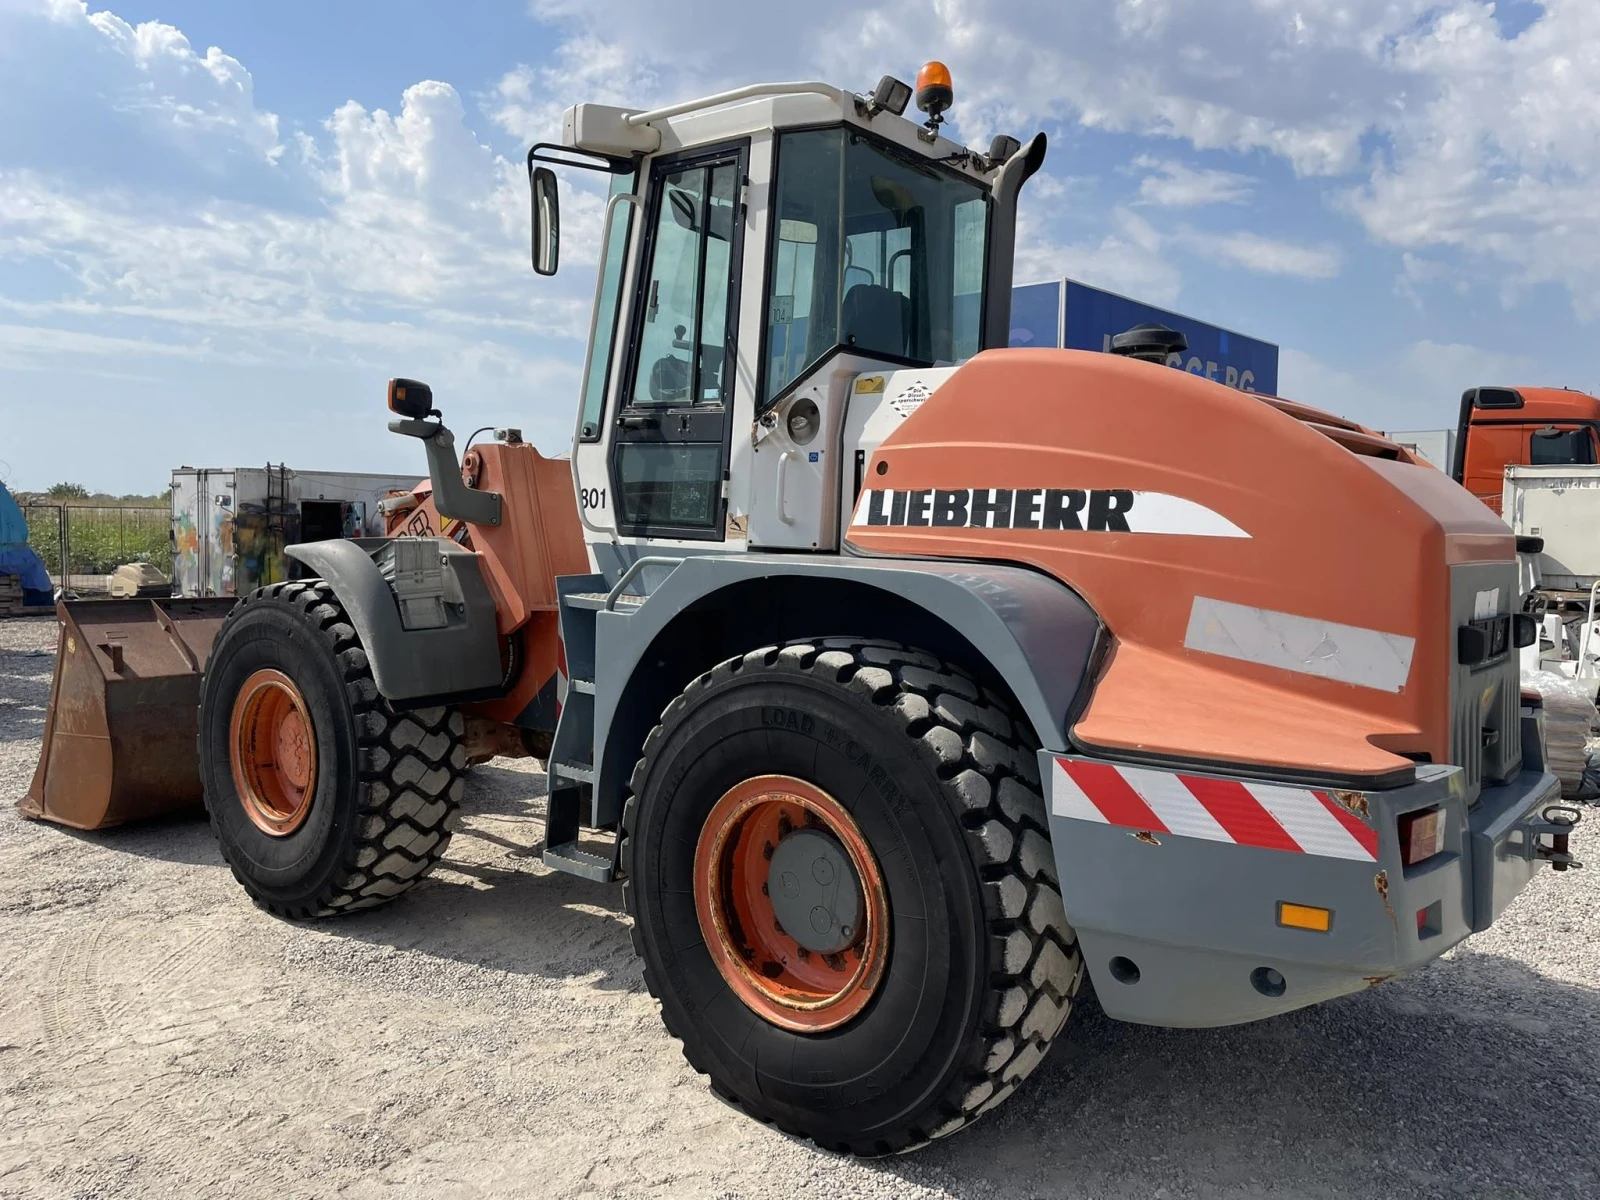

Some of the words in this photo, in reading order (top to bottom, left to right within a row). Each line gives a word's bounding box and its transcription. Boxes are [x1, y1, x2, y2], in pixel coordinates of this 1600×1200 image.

[866, 489, 1135, 533] LIEBHERR
[761, 707, 816, 735] LOAD
[845, 740, 911, 819] CARRY
